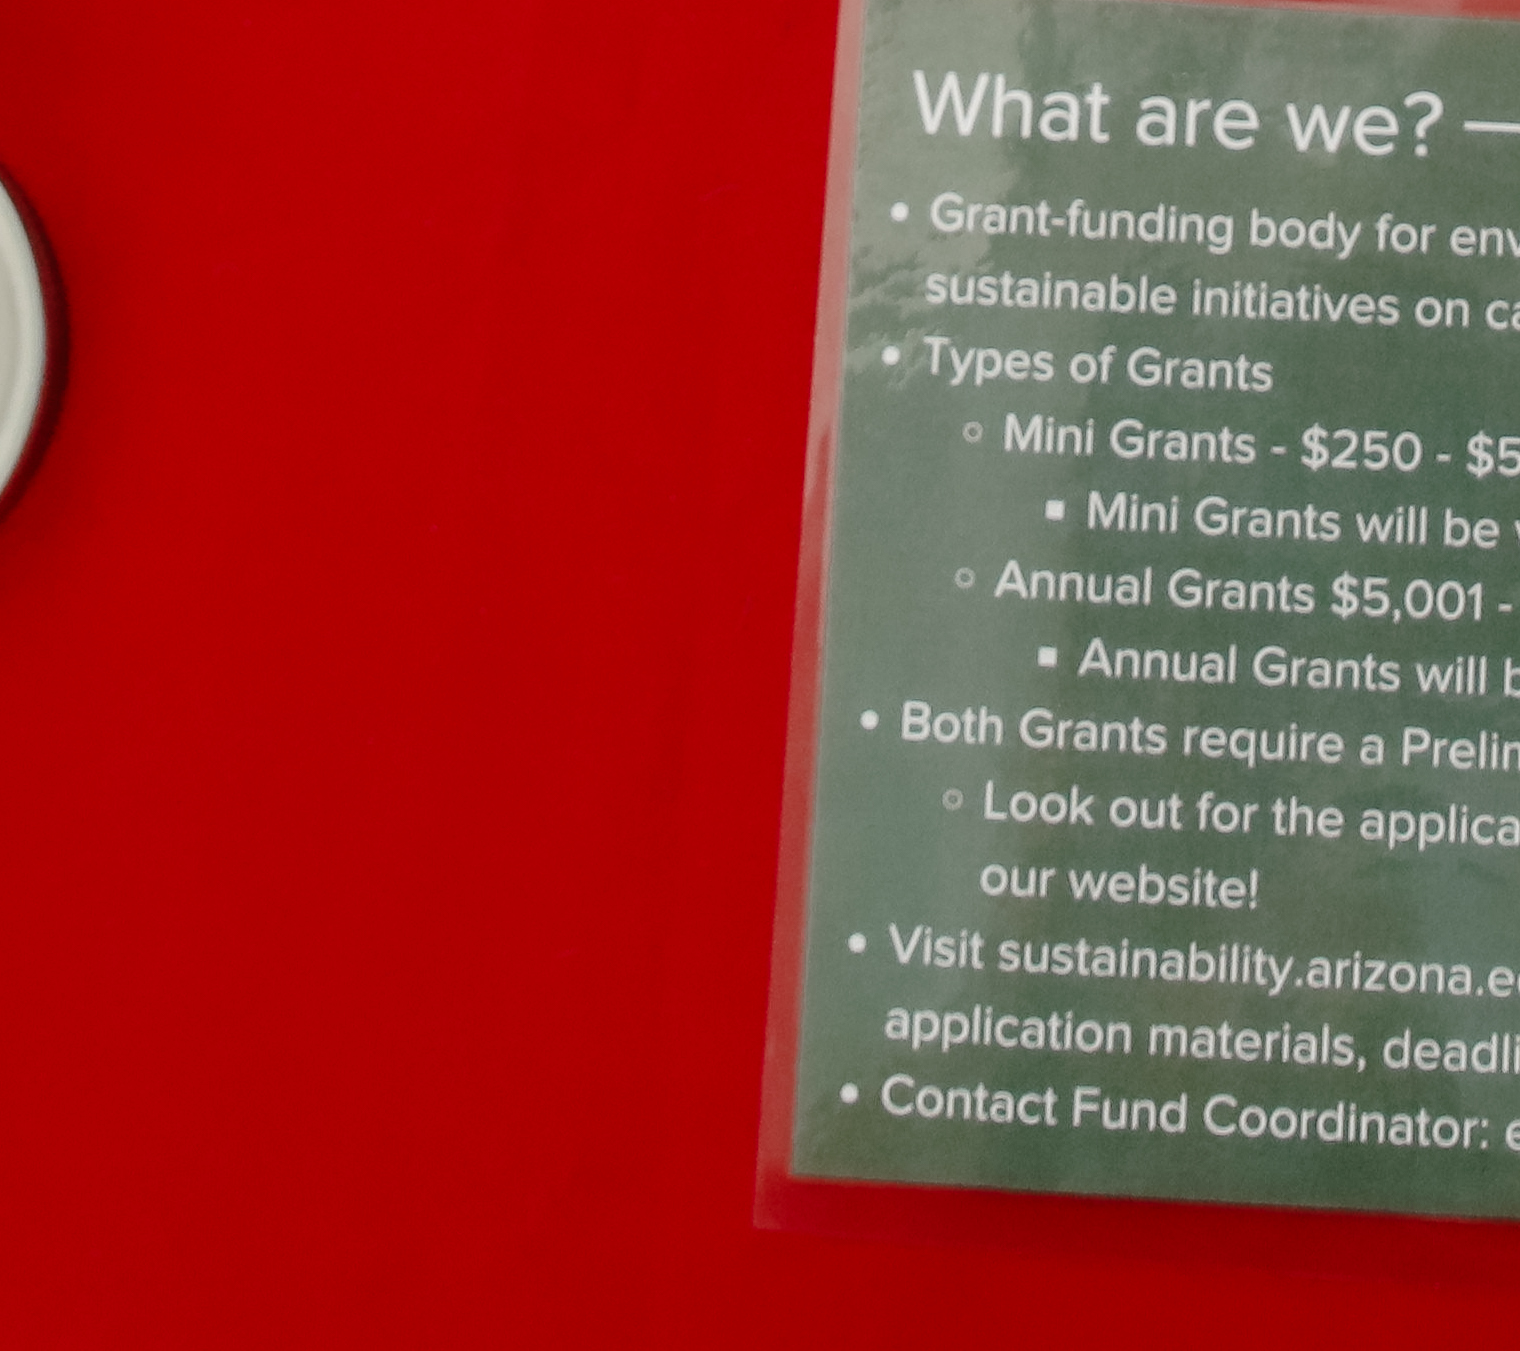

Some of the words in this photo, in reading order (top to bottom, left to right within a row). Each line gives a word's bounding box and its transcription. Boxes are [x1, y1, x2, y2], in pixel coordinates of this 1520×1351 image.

[912, 69, 1111, 144] What
[1134, 95, 1260, 151] are
[1285, 89, 1444, 158] we?
[929, 191, 1234, 255] Grant-funding
[1248, 206, 1363, 260] body
[1374, 211, 1438, 255] for
[925, 270, 1177, 316] sustainable
[1191, 277, 1401, 327] initiatives
[1413, 295, 1471, 328] on
[921, 334, 1055, 387] Types
[1068, 343, 1116, 384] of
[1125, 345, 1274, 393] Grants
[1003, 411, 1094, 455] Mini
[1108, 417, 1257, 465] Grants
[1299, 422, 1423, 473] $250
[1086, 489, 1179, 533] Mini
[1192, 494, 1342, 542] Grants
[1354, 503, 1428, 546] will
[1442, 506, 1501, 550] be
[993, 559, 1153, 606] Annual
[1166, 567, 1316, 615] Grants
[1330, 570, 1483, 624] $5,001
[1076, 636, 1238, 684] Annual
[1251, 644, 1401, 693] Grants
[1414, 654, 1488, 696] will
[900, 699, 1004, 745] Both
[1018, 706, 1168, 756] Grants
[1181, 722, 1345, 769] require
[1358, 733, 1385, 767] a
[983, 779, 1095, 826] Look
[1108, 792, 1184, 831] out
[1194, 790, 1260, 833] for
[1270, 795, 1345, 840] the
[978, 863, 1056, 898] our
[1067, 862, 1259, 910] website!
[887, 921, 984, 970] Visit
[883, 1004, 1132, 1054] application
[1148, 1020, 1366, 1073] materials,
[880, 1073, 1058, 1127] Contact
[1071, 1085, 1188, 1134] Fund
[1202, 1093, 1489, 1150] Coordinator:
